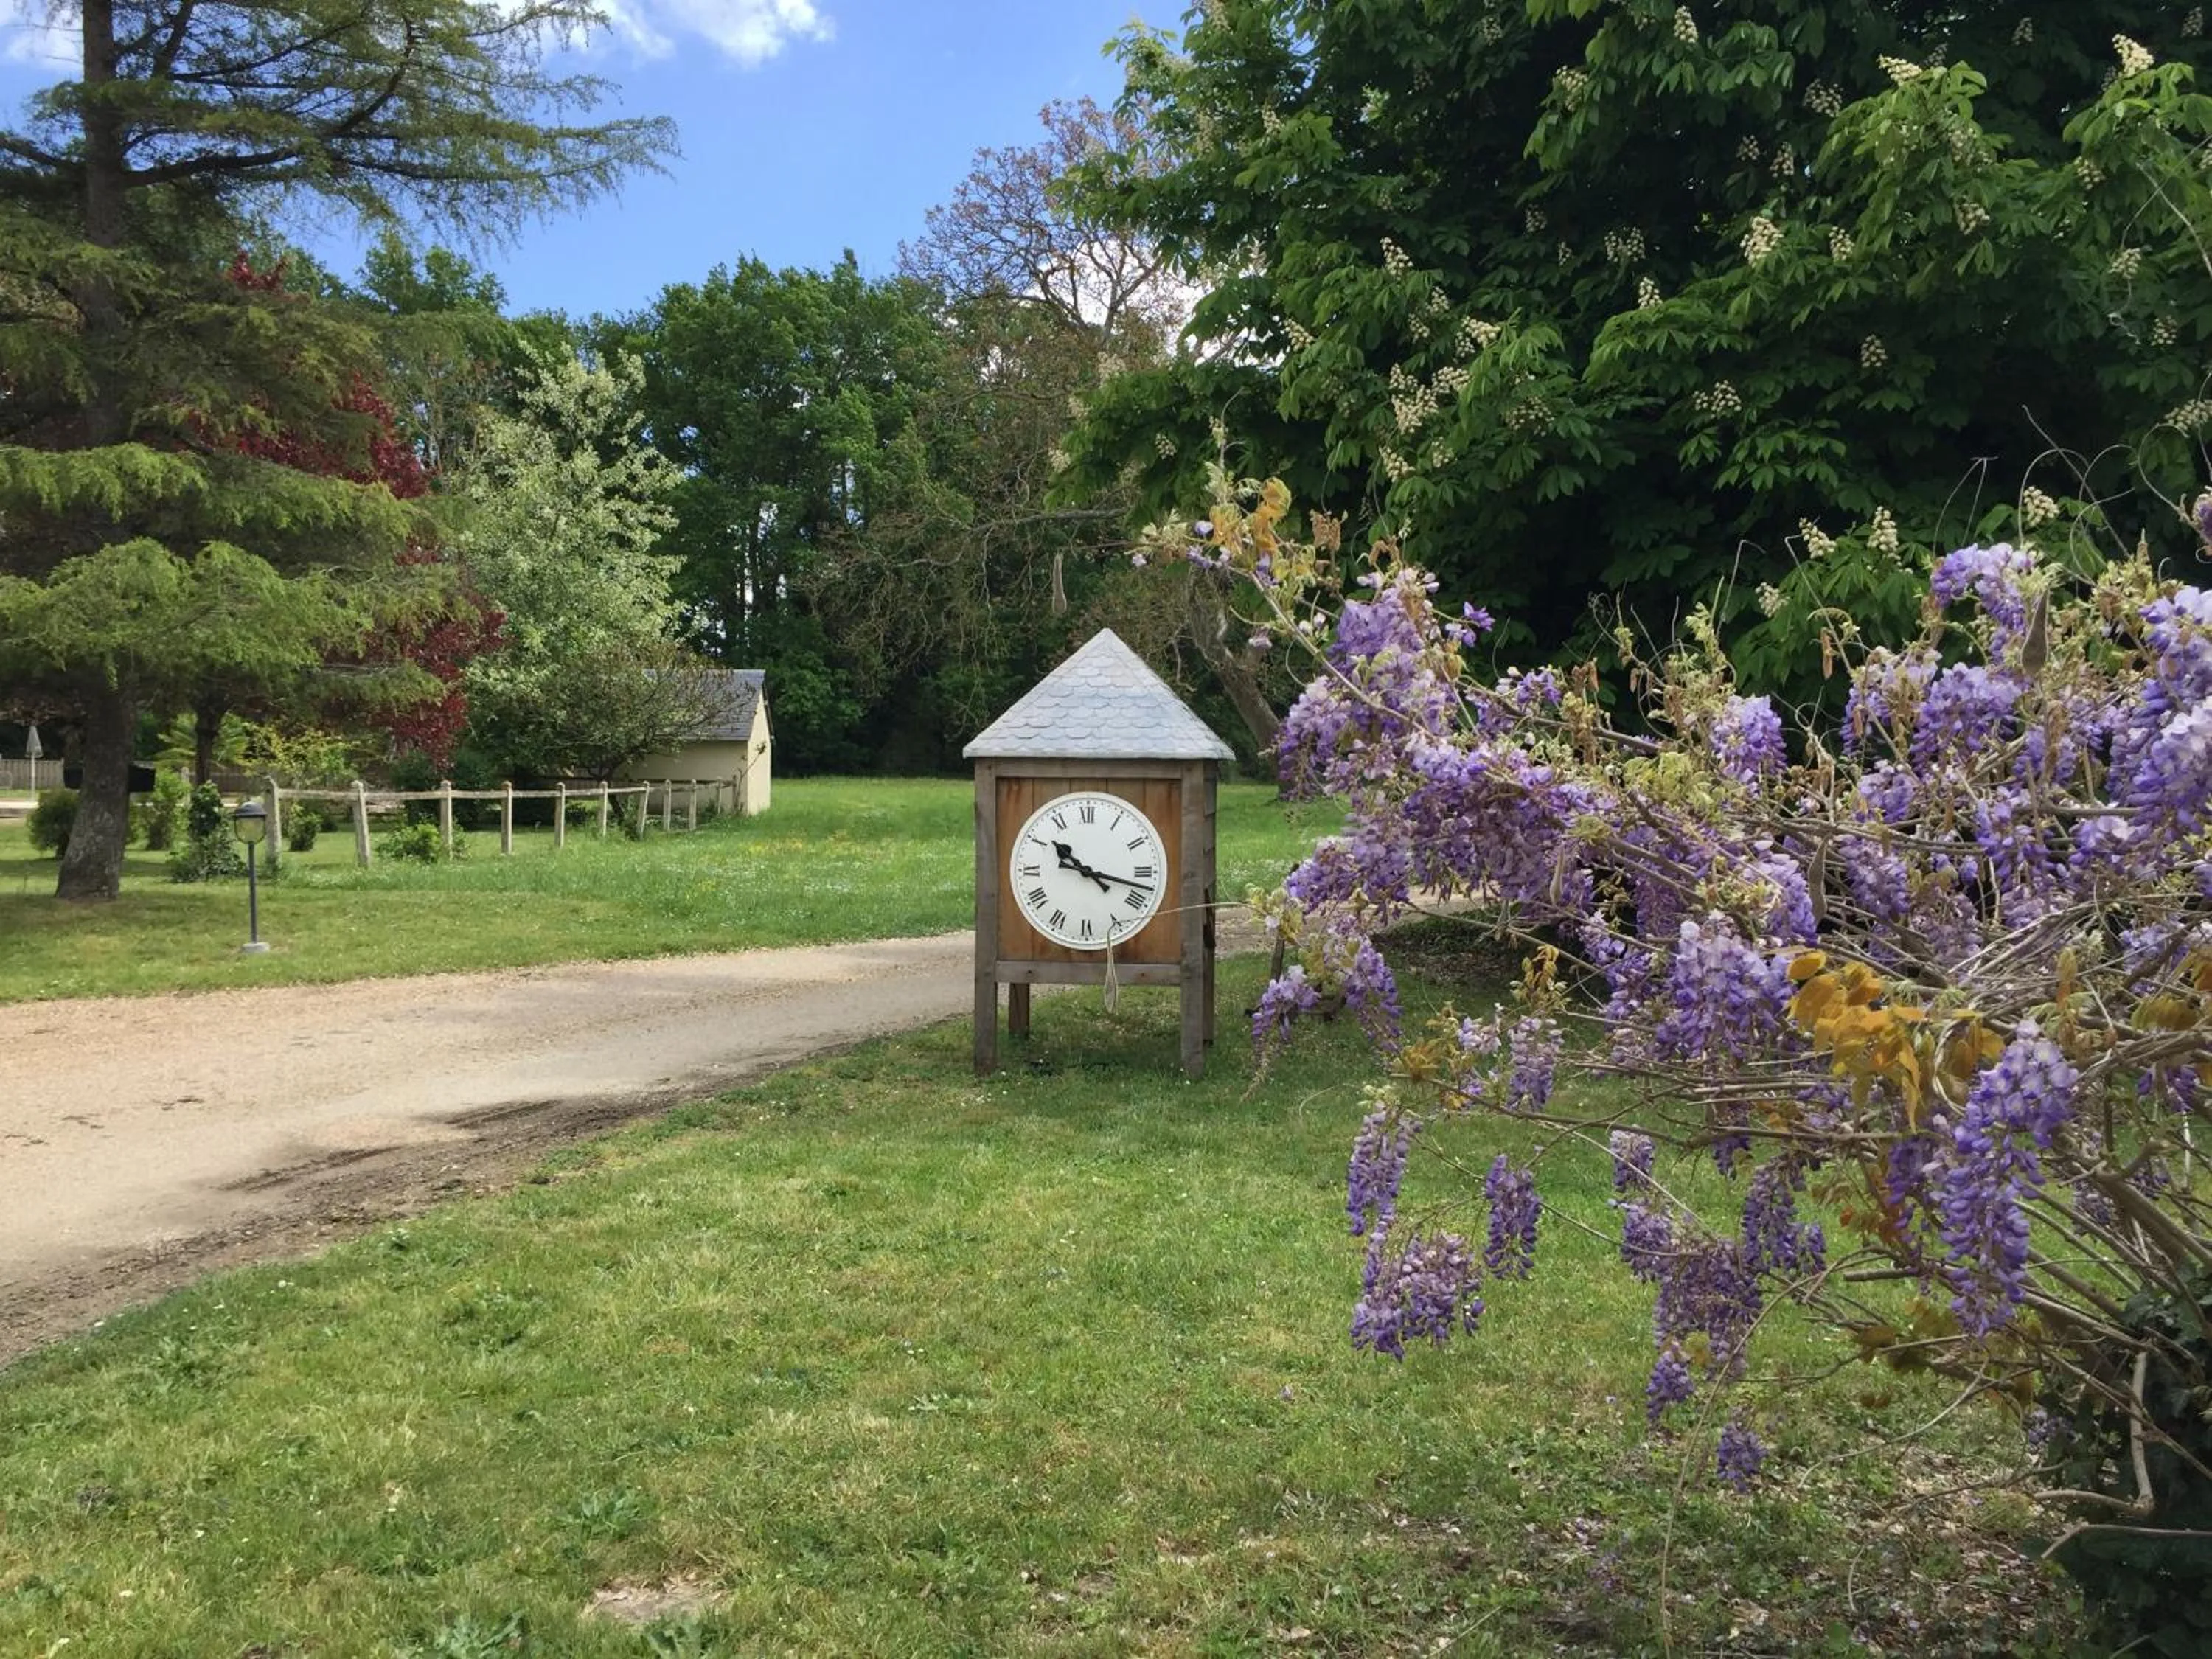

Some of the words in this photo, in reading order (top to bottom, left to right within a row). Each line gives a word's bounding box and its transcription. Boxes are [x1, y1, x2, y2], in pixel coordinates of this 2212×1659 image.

[1078, 806, 1095, 824] XII
[1127, 836, 1145, 851] II
[1133, 866, 1152, 878] III
